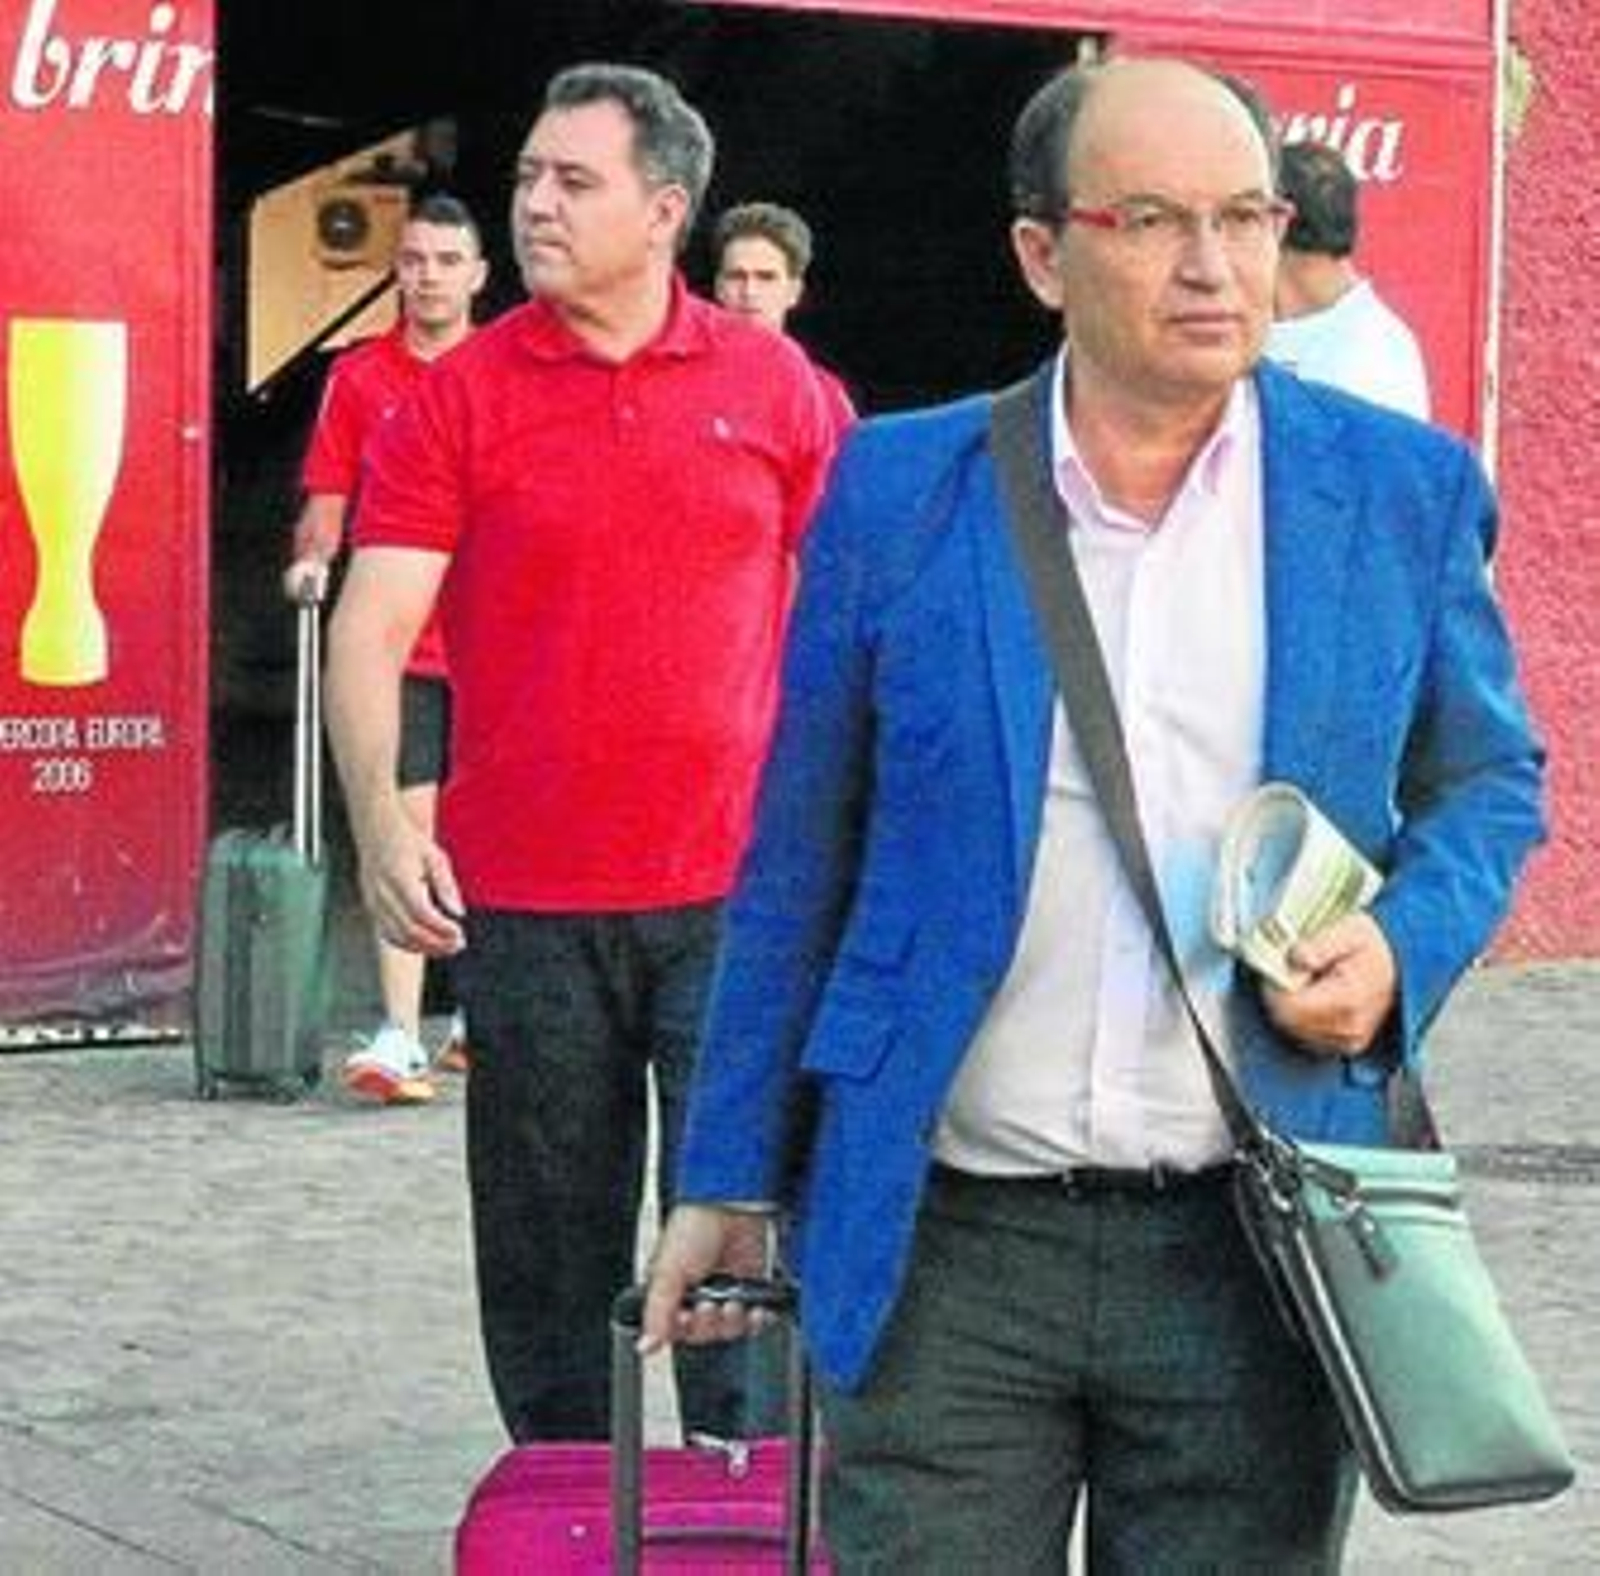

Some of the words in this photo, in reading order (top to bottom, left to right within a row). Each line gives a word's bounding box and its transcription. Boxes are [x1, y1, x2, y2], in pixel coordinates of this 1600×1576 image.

[1270, 83, 1404, 183] ria
[0, 717, 79, 749] ERCOPA
[32, 758, 92, 791] 2006
